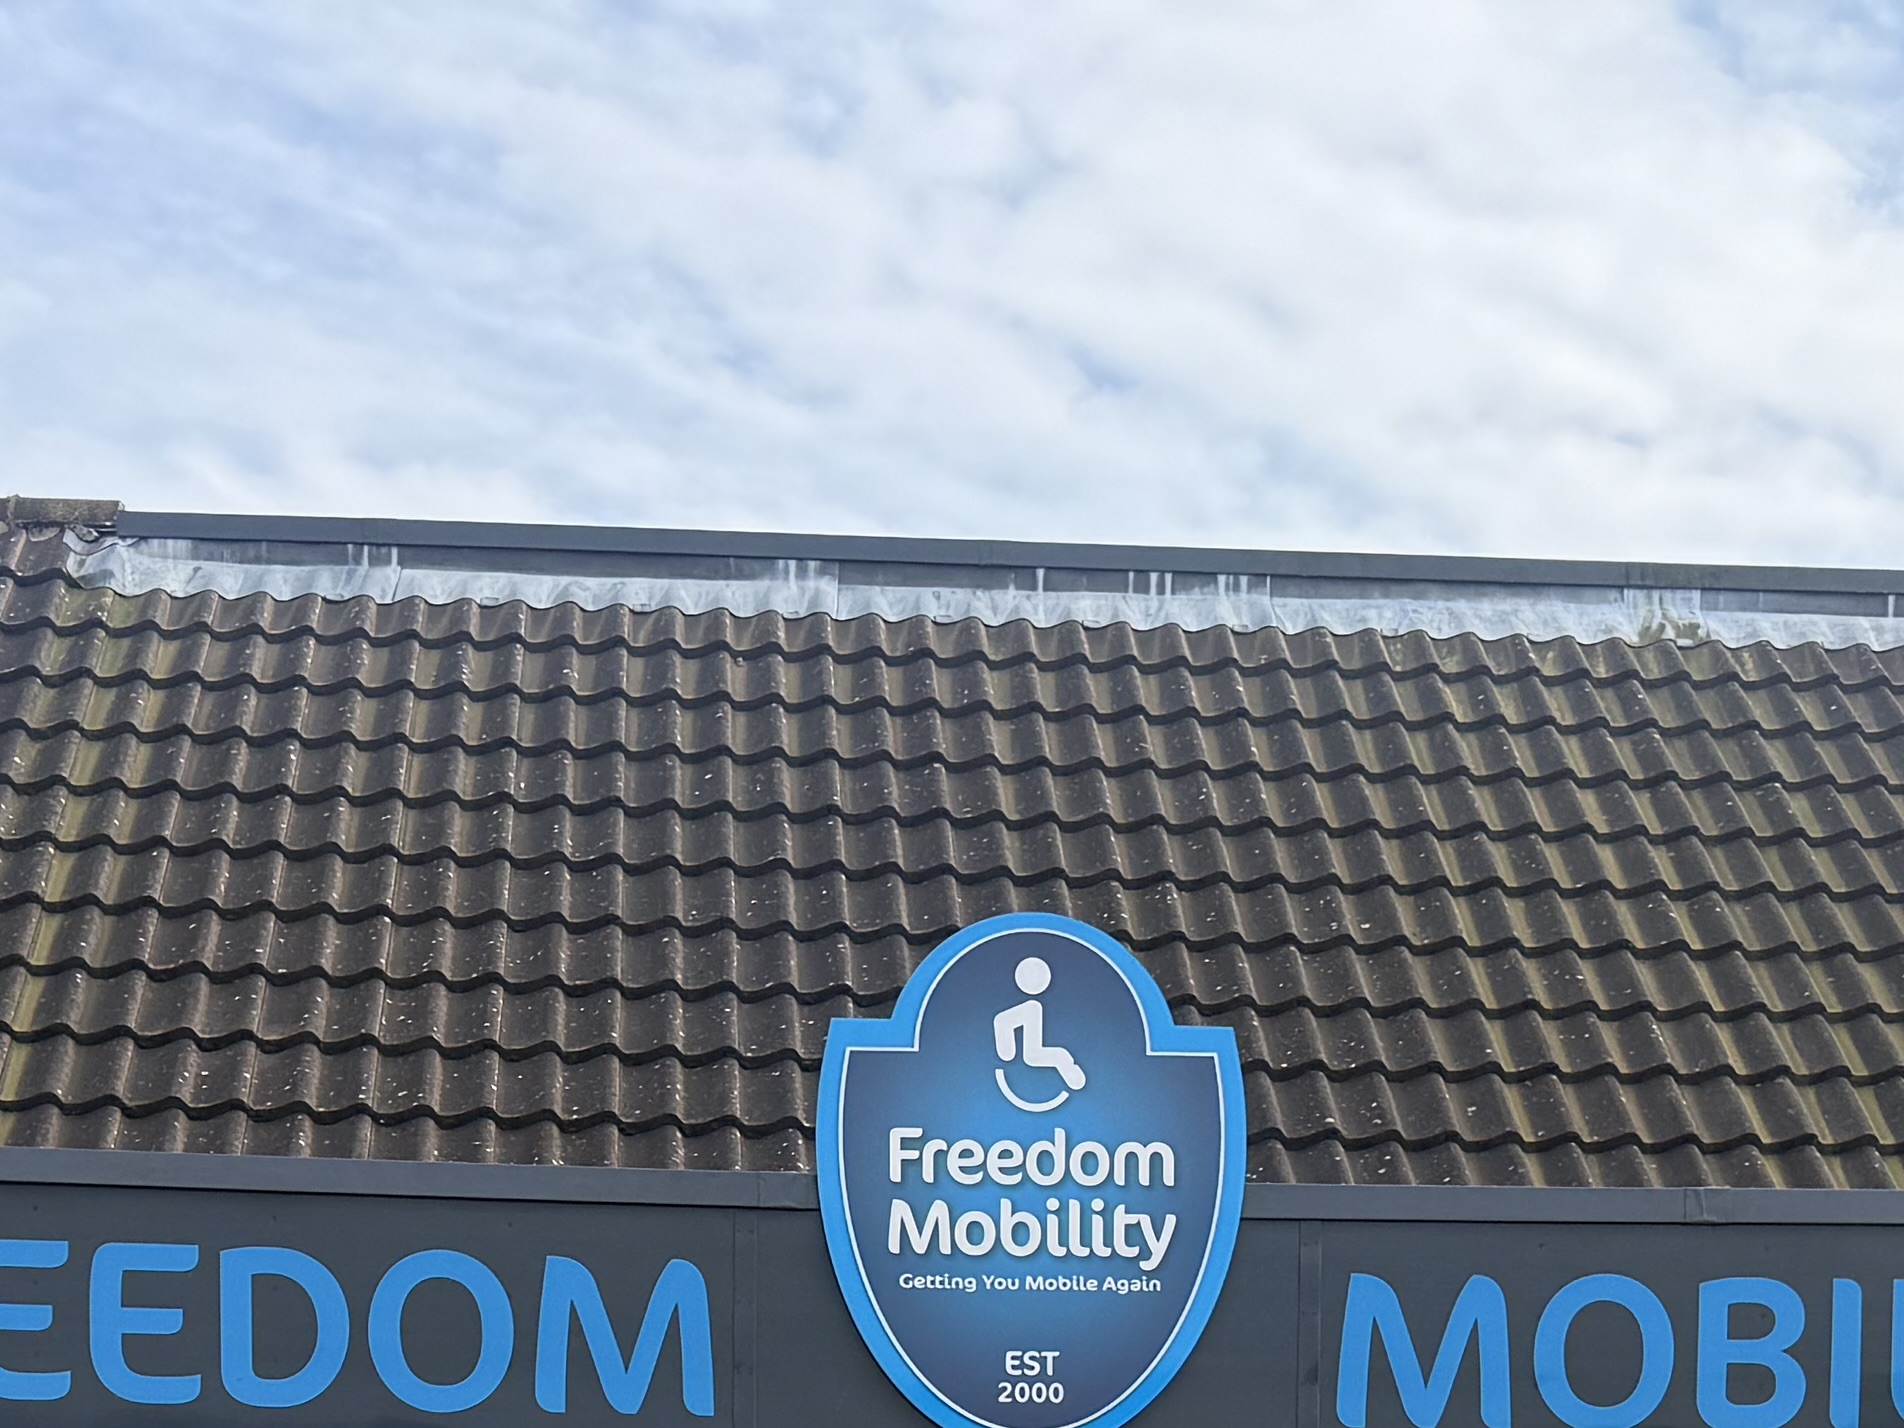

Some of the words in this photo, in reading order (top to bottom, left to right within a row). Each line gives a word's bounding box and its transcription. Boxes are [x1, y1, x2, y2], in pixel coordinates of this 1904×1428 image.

[889, 1127, 1175, 1187] Freedom
[888, 1197, 1177, 1271] Mobility
[899, 1273, 977, 1293] Getting
[981, 1274, 1020, 1291] You
[1025, 1275, 1099, 1292] Mobile
[1102, 1275, 1161, 1294] Again
[1005, 1350, 1060, 1376] EST
[998, 1381, 1065, 1404] 2000
